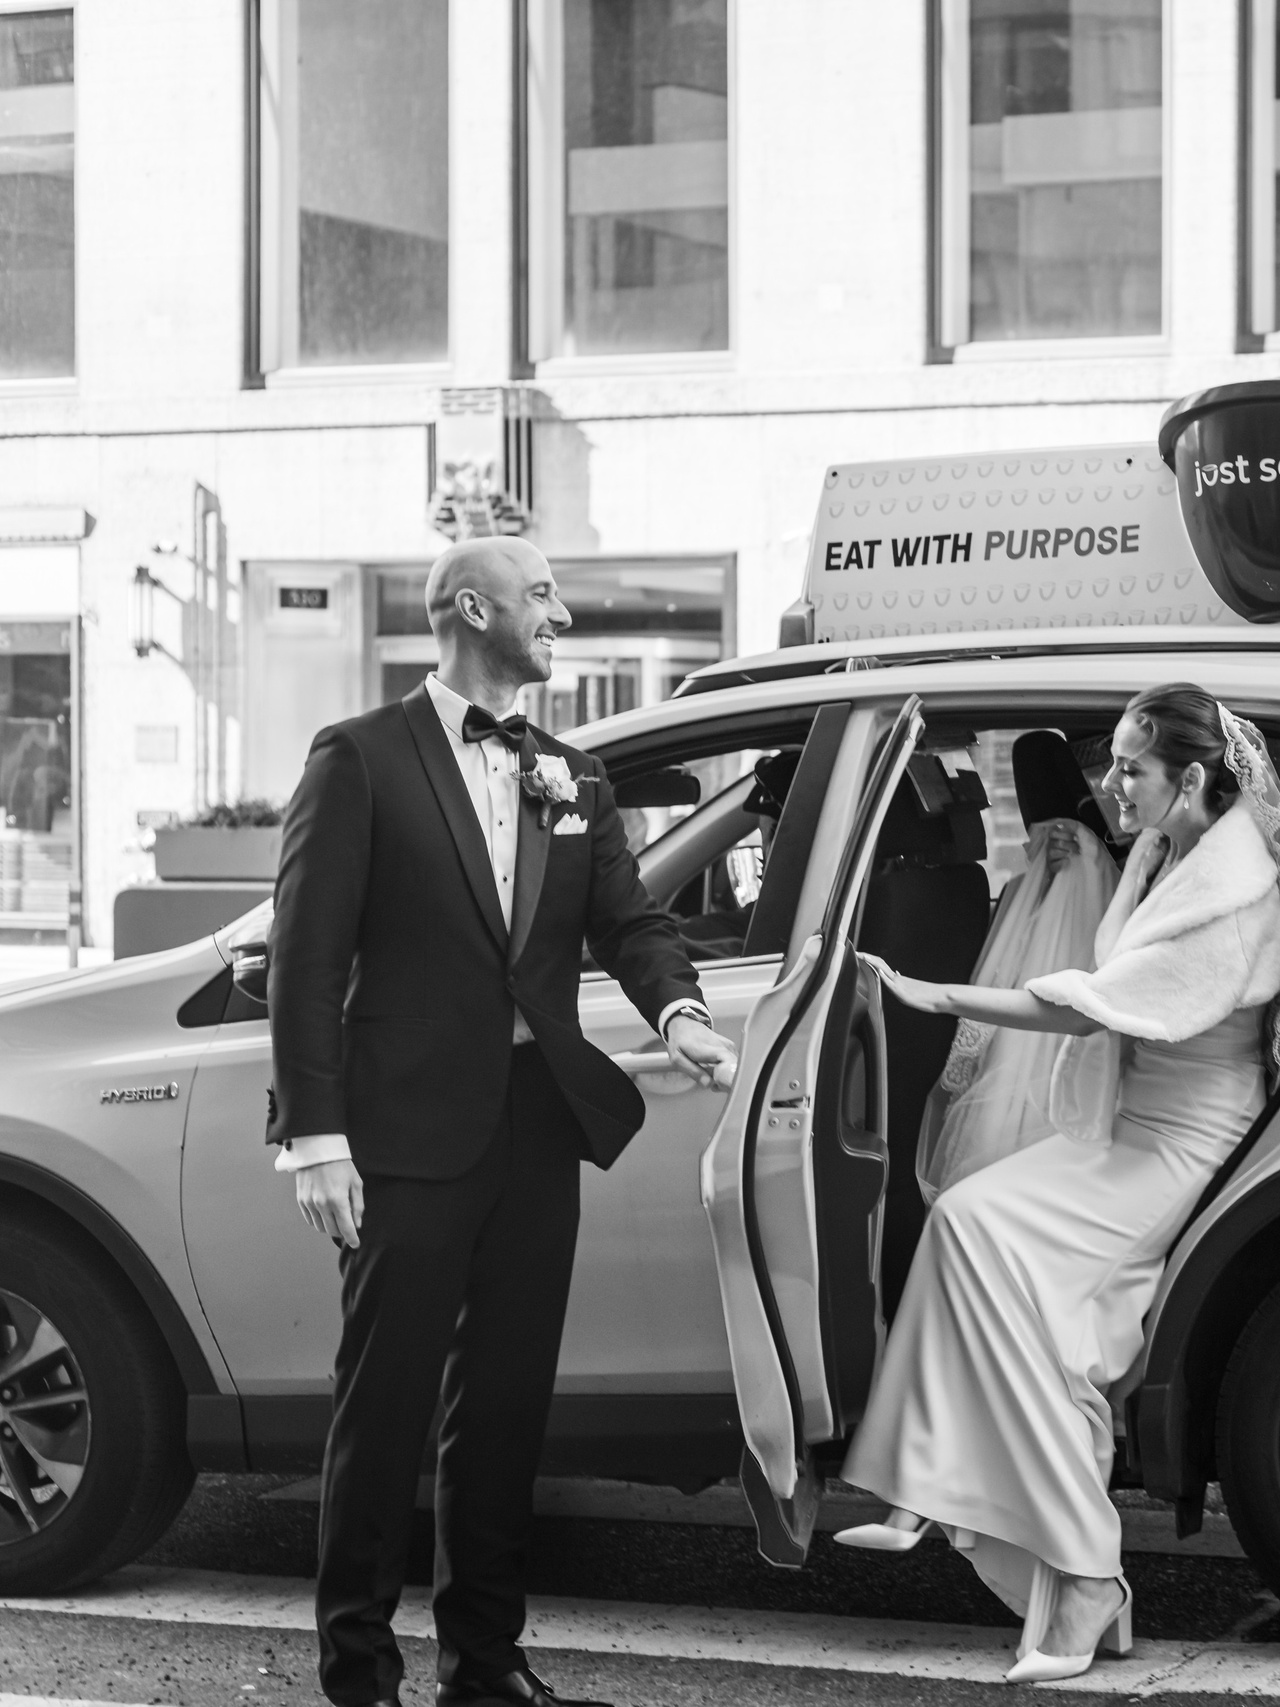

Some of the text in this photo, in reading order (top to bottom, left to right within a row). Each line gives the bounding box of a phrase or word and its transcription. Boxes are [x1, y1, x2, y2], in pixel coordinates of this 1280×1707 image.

[1194, 460, 1251, 497] just
[825, 524, 1140, 571] EAT WITH PURPOSE
[100, 1085, 166, 1104] HYBRID
